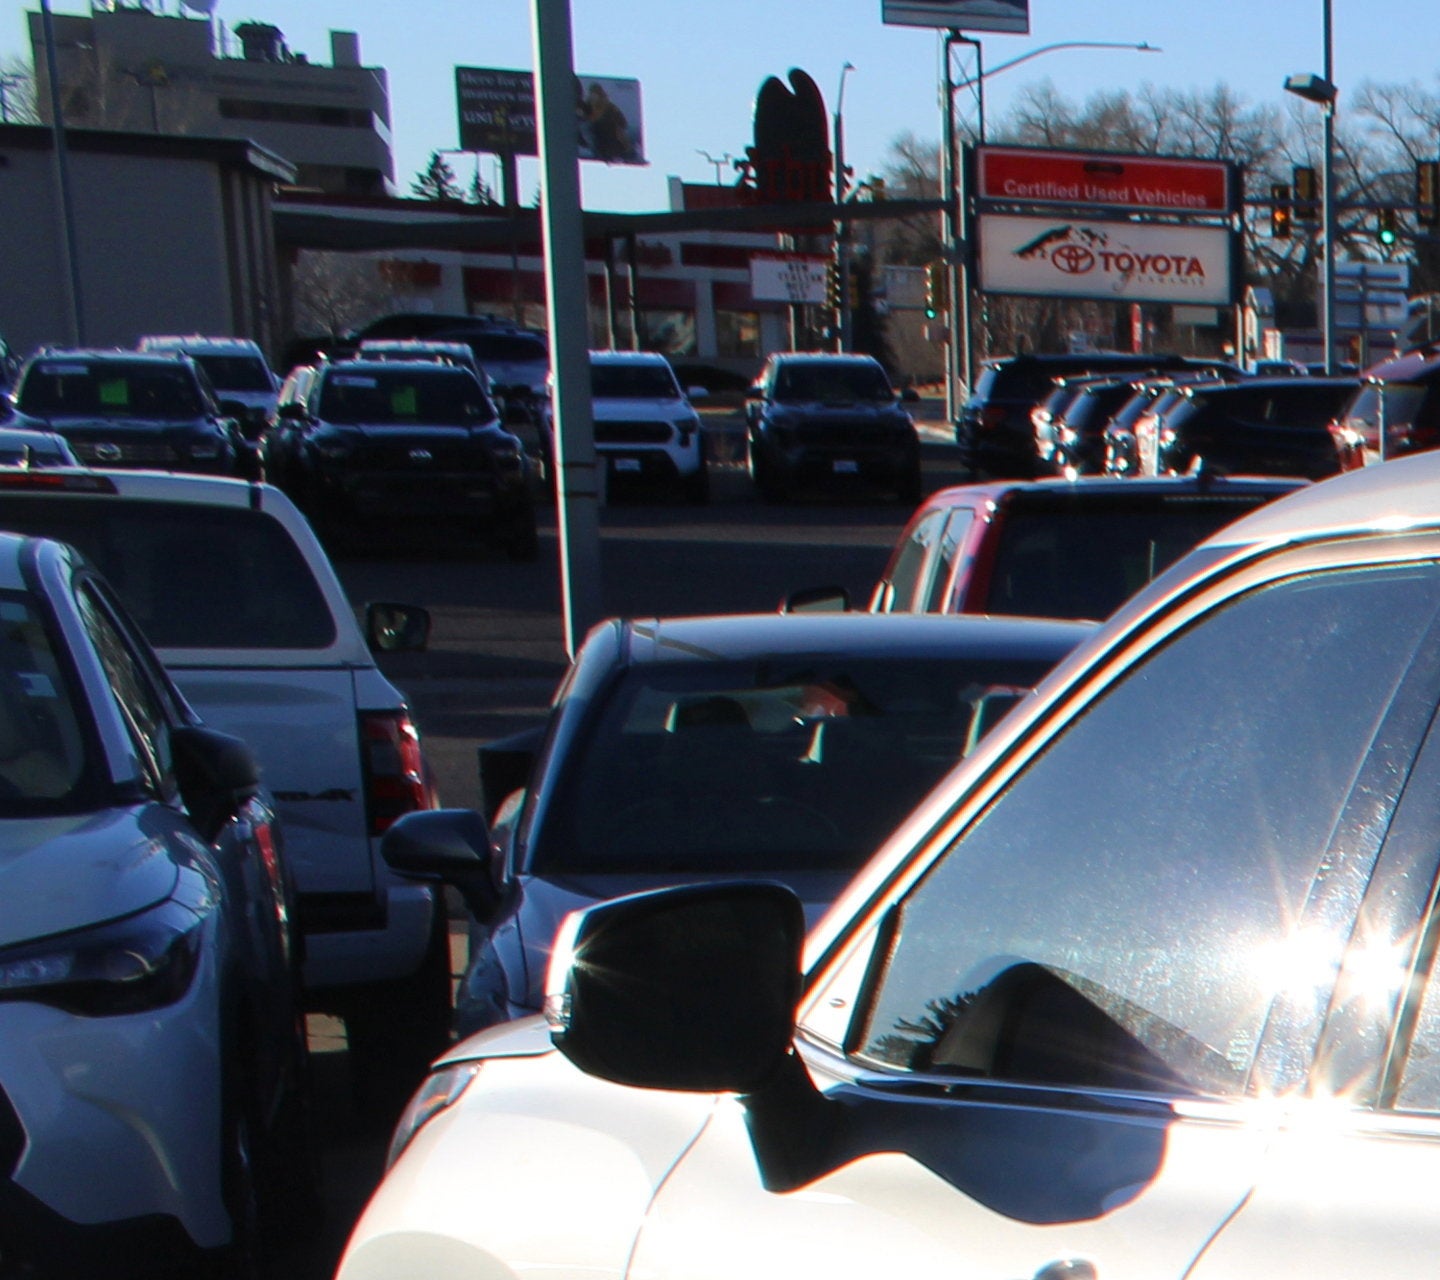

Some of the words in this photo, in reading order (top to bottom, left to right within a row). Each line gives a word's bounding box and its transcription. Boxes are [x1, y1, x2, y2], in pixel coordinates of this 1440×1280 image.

[1003, 178, 1080, 199] Certified
[1084, 184, 1129, 201] Used
[1133, 186, 1208, 208] Vehicles
[1098, 251, 1205, 278] TOYOTA
